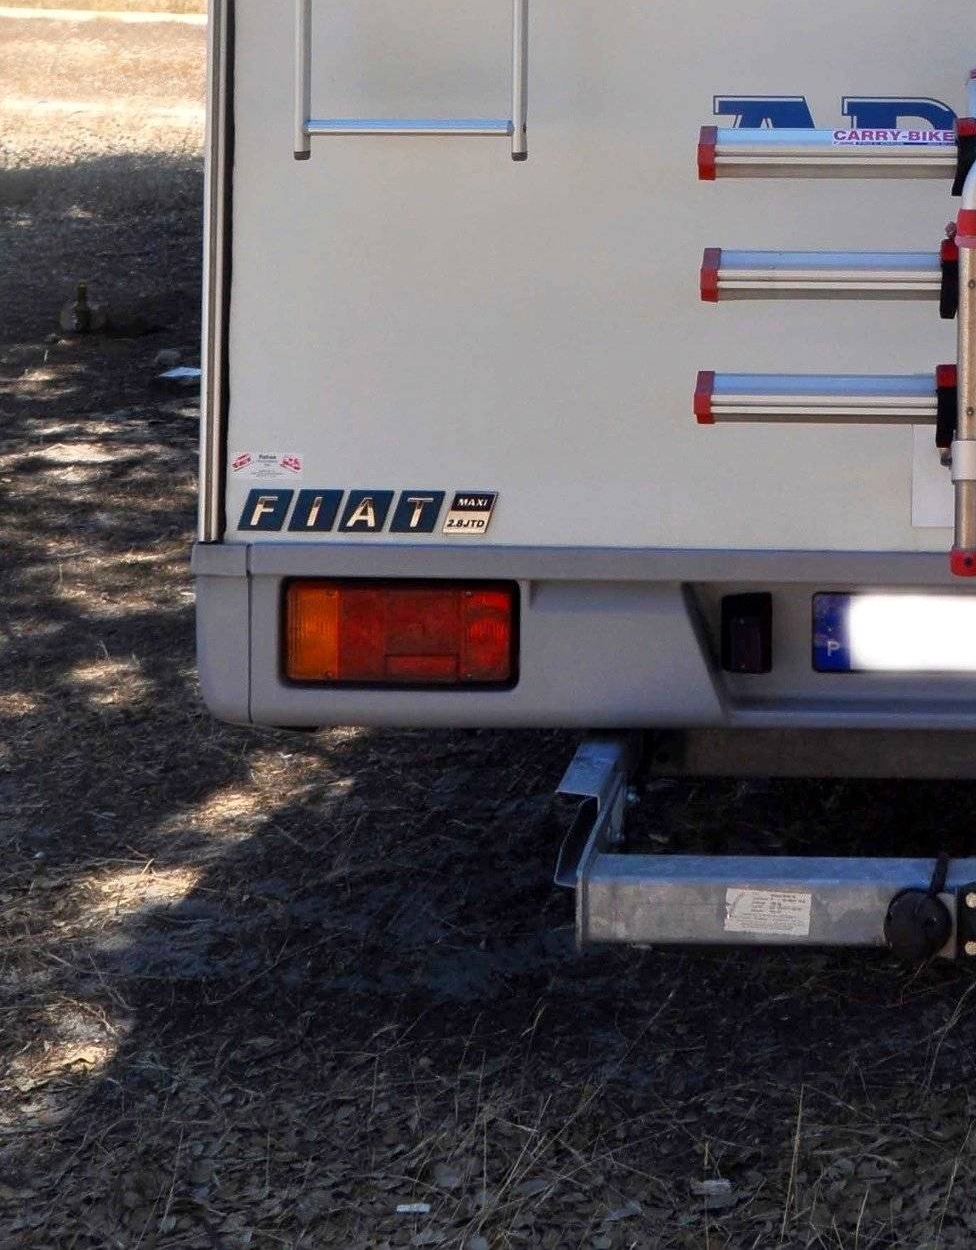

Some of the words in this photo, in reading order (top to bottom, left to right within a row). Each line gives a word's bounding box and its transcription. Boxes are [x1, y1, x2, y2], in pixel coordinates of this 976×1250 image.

[833, 129, 955, 142] CARRY-BIKE
[457, 497, 488, 507] MAXI
[249, 495, 434, 528] FIAT
[827, 640, 840, 657] P
